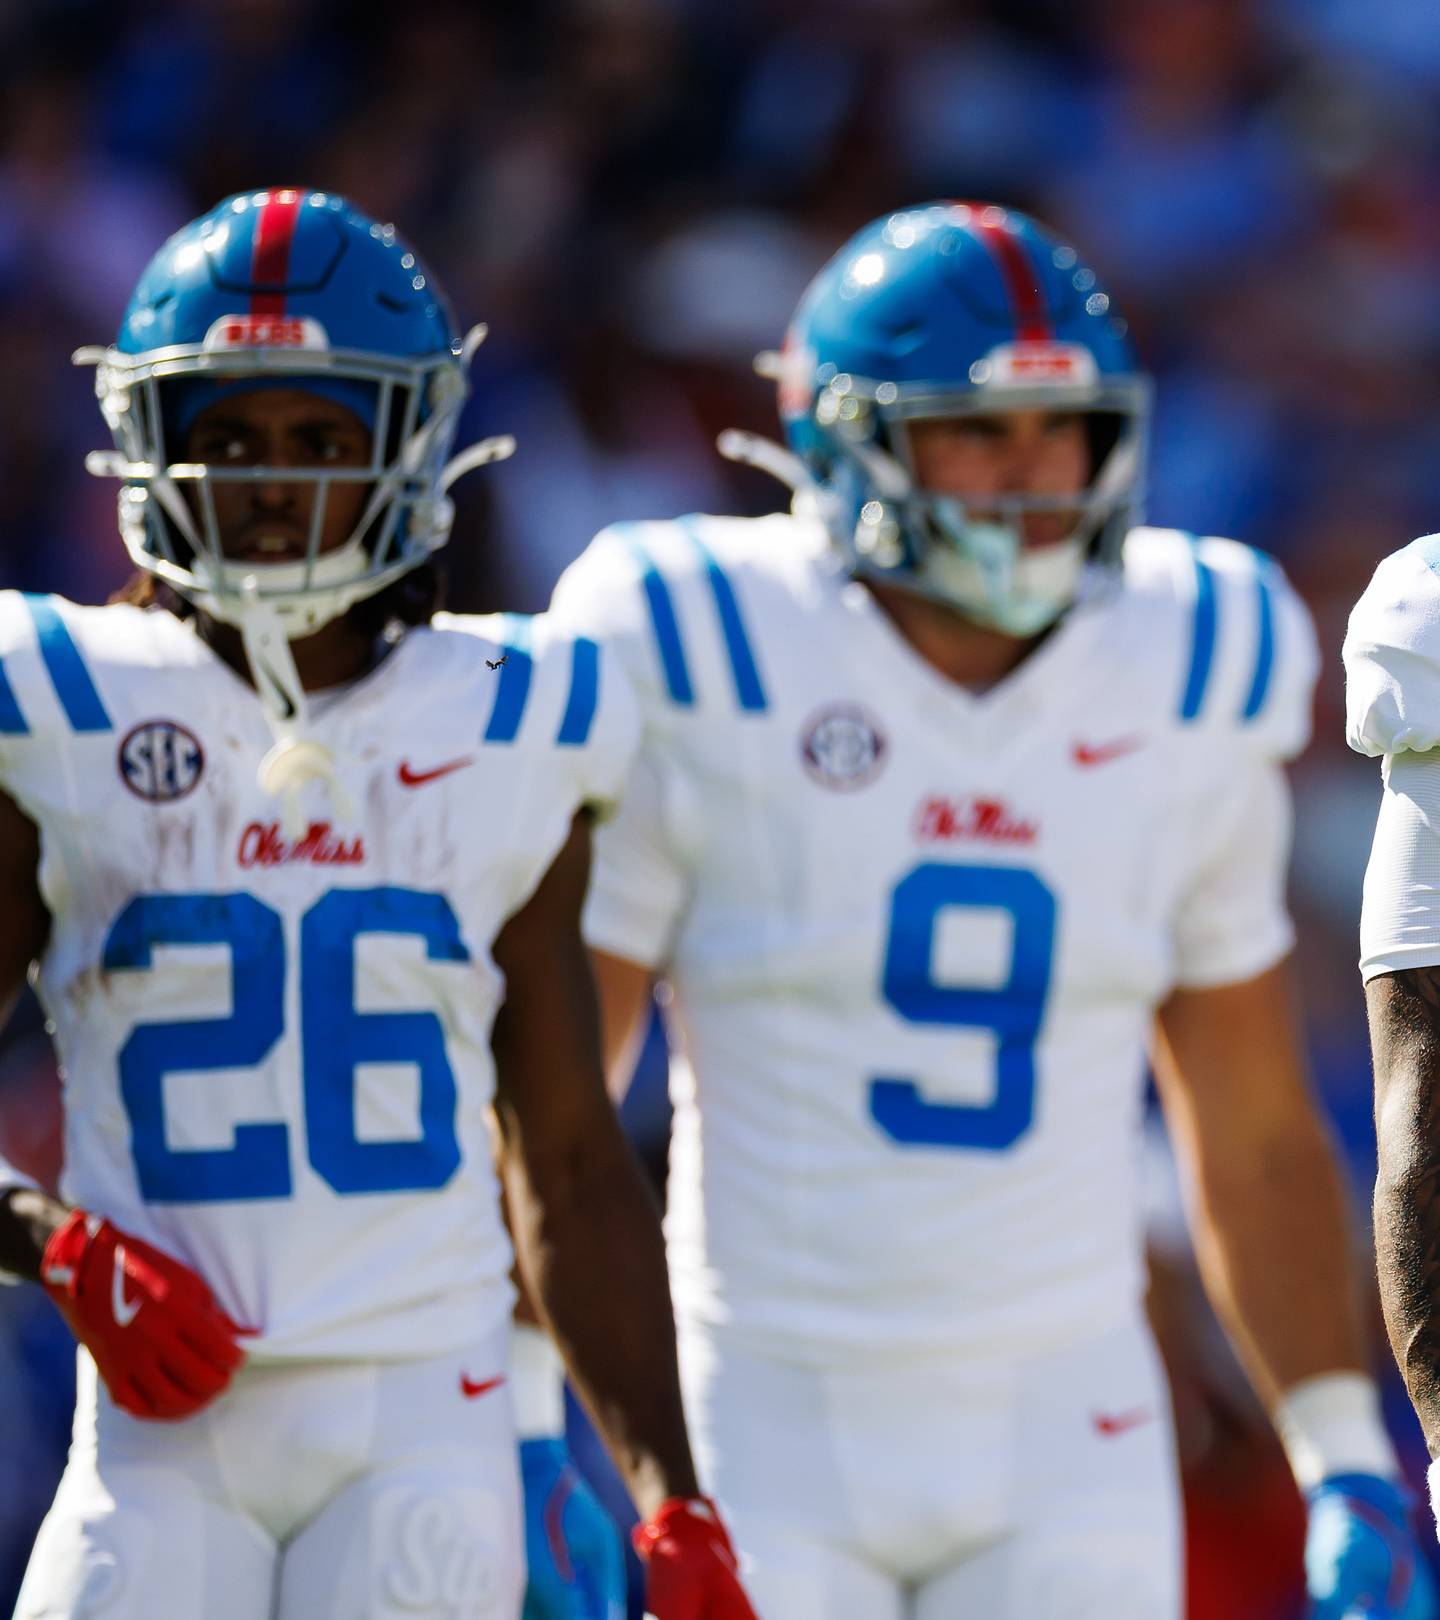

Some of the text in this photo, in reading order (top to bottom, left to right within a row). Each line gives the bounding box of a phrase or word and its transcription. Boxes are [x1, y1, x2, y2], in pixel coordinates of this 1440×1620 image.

[123, 725, 200, 796] SEC
[238, 818, 366, 868] Ole Miss
[100, 884, 472, 1206] 26
[867, 860, 1058, 1155] 9
